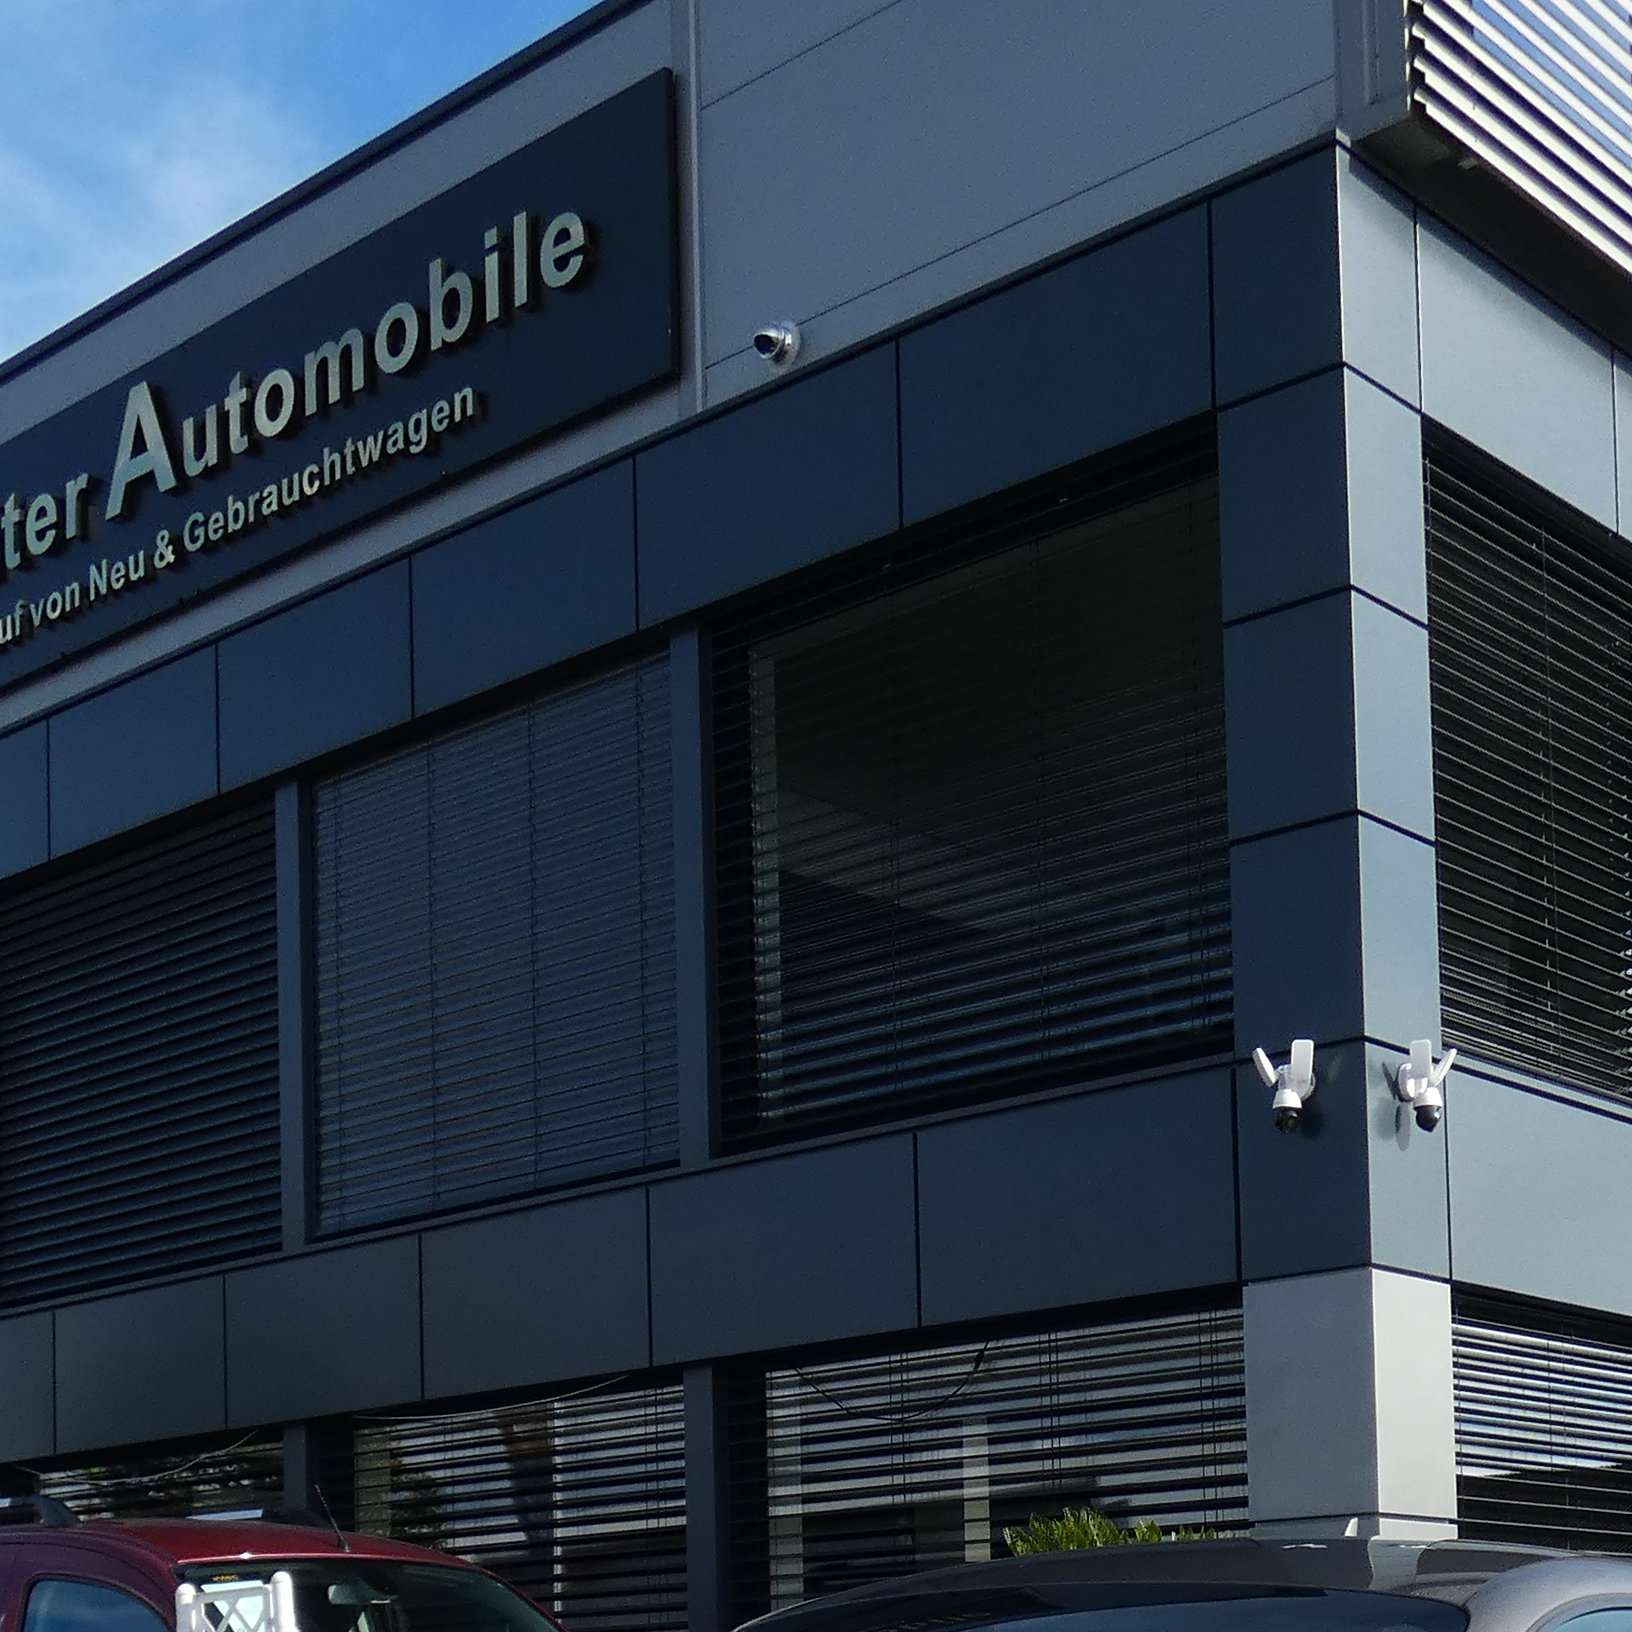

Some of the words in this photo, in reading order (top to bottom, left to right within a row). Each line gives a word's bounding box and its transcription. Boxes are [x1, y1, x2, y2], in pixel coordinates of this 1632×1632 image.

[105, 211, 585, 520] Automobile
[30, 582, 80, 628] von
[89, 550, 145, 601] Neu
[153, 529, 176, 569] &
[183, 386, 475, 552] Gebrauchtwagen
